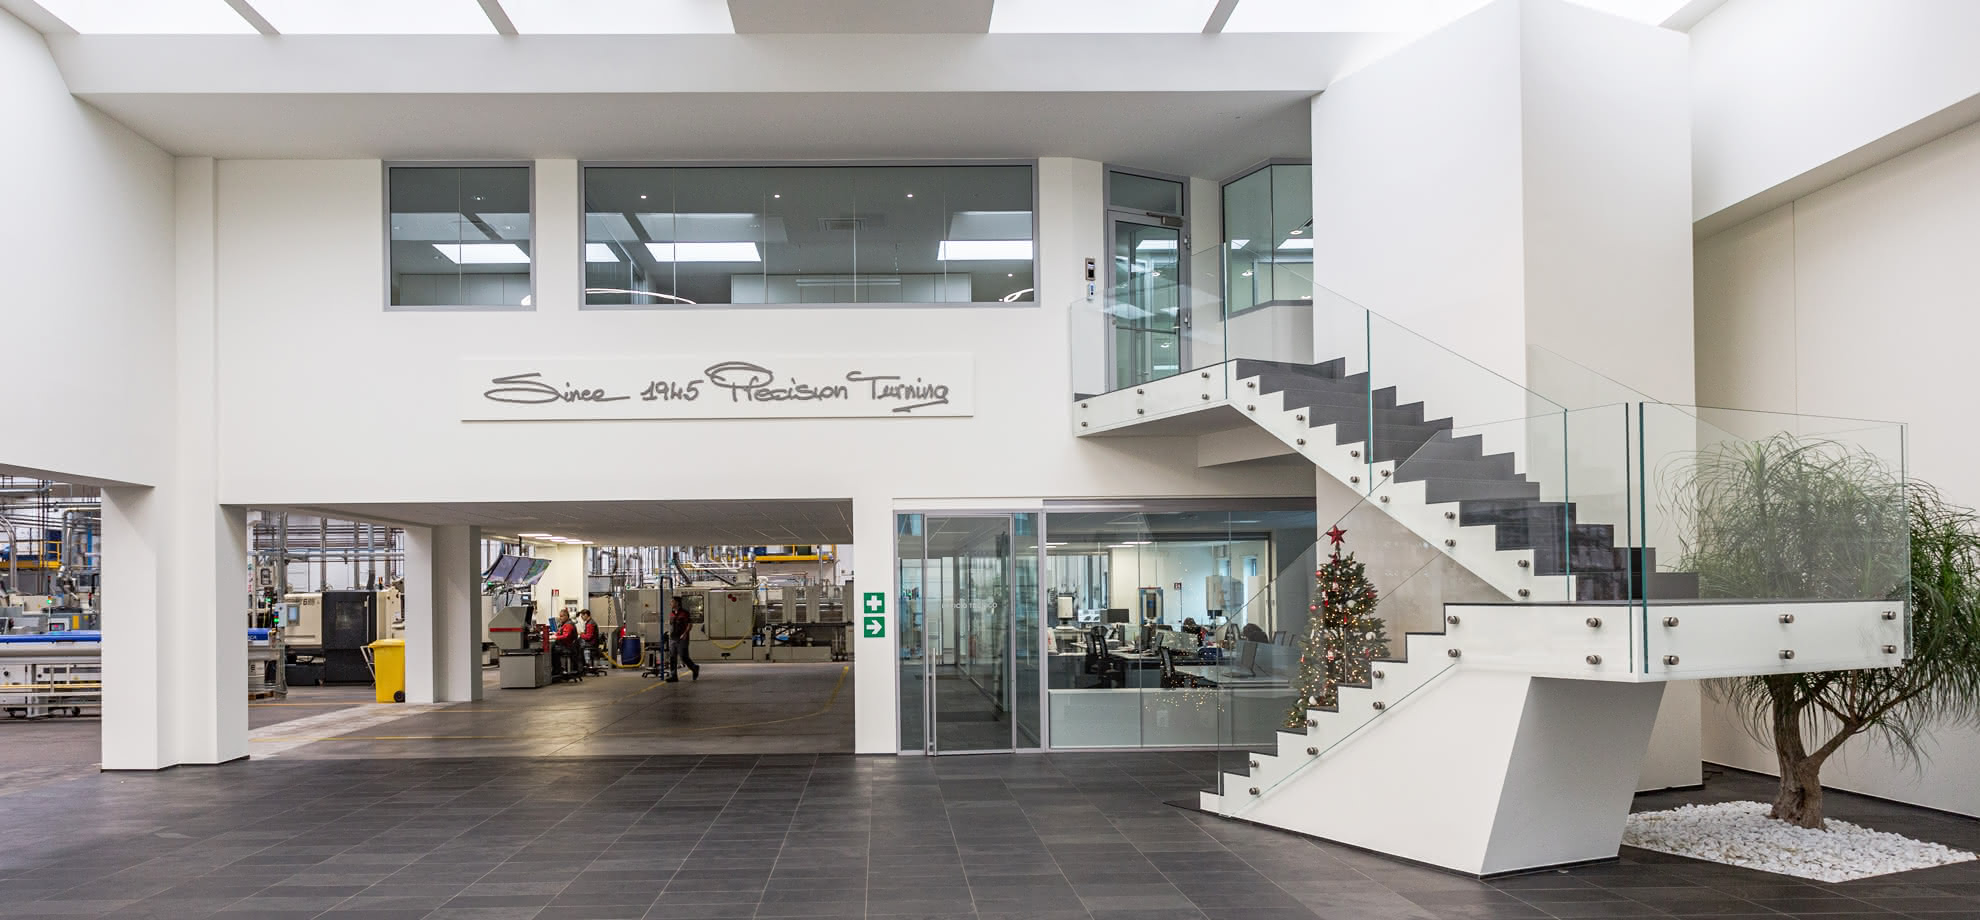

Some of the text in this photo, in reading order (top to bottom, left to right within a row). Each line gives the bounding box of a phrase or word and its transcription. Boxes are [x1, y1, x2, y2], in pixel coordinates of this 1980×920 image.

[484, 361, 949, 413] Since 1945 Precision Turning
